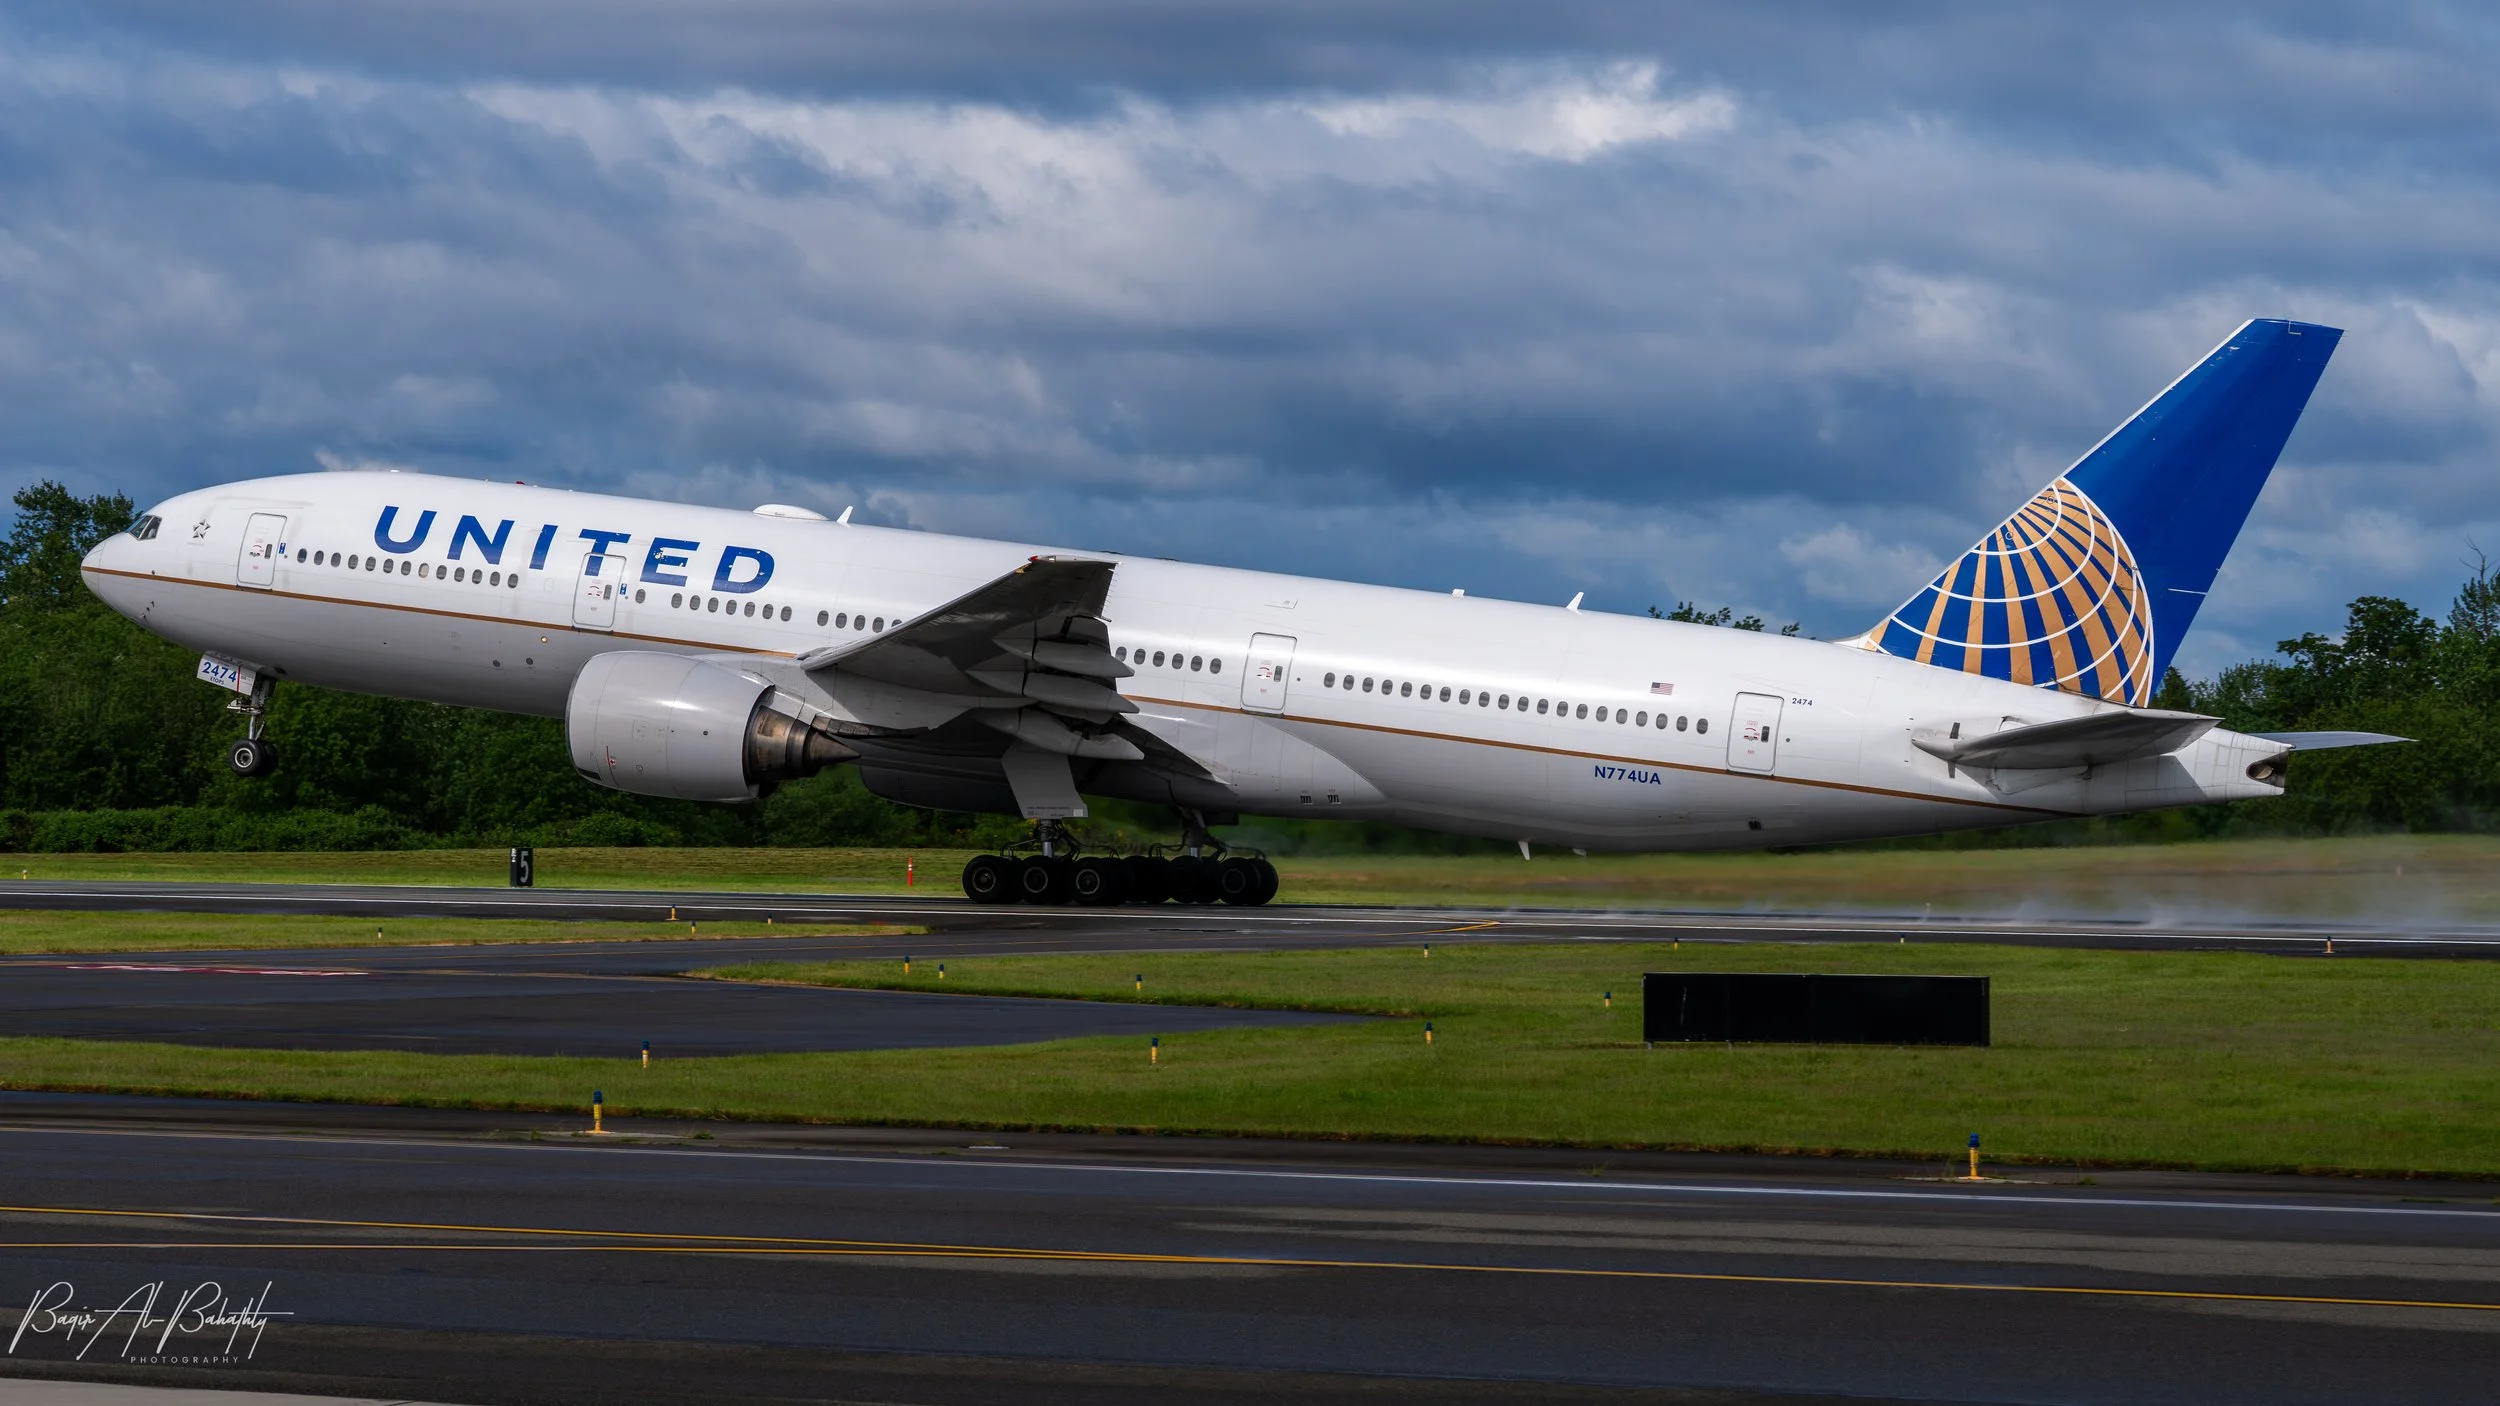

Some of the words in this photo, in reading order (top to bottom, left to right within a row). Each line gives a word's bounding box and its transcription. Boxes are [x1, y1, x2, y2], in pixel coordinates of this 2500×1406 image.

[374, 505, 776, 593] UNITED
[202, 661, 238, 683] 2474
[209, 676, 225, 685] ETOPS
[1791, 697, 1813, 706] 2474
[1594, 765, 1662, 785] N774UA
[520, 850, 529, 883] 5
